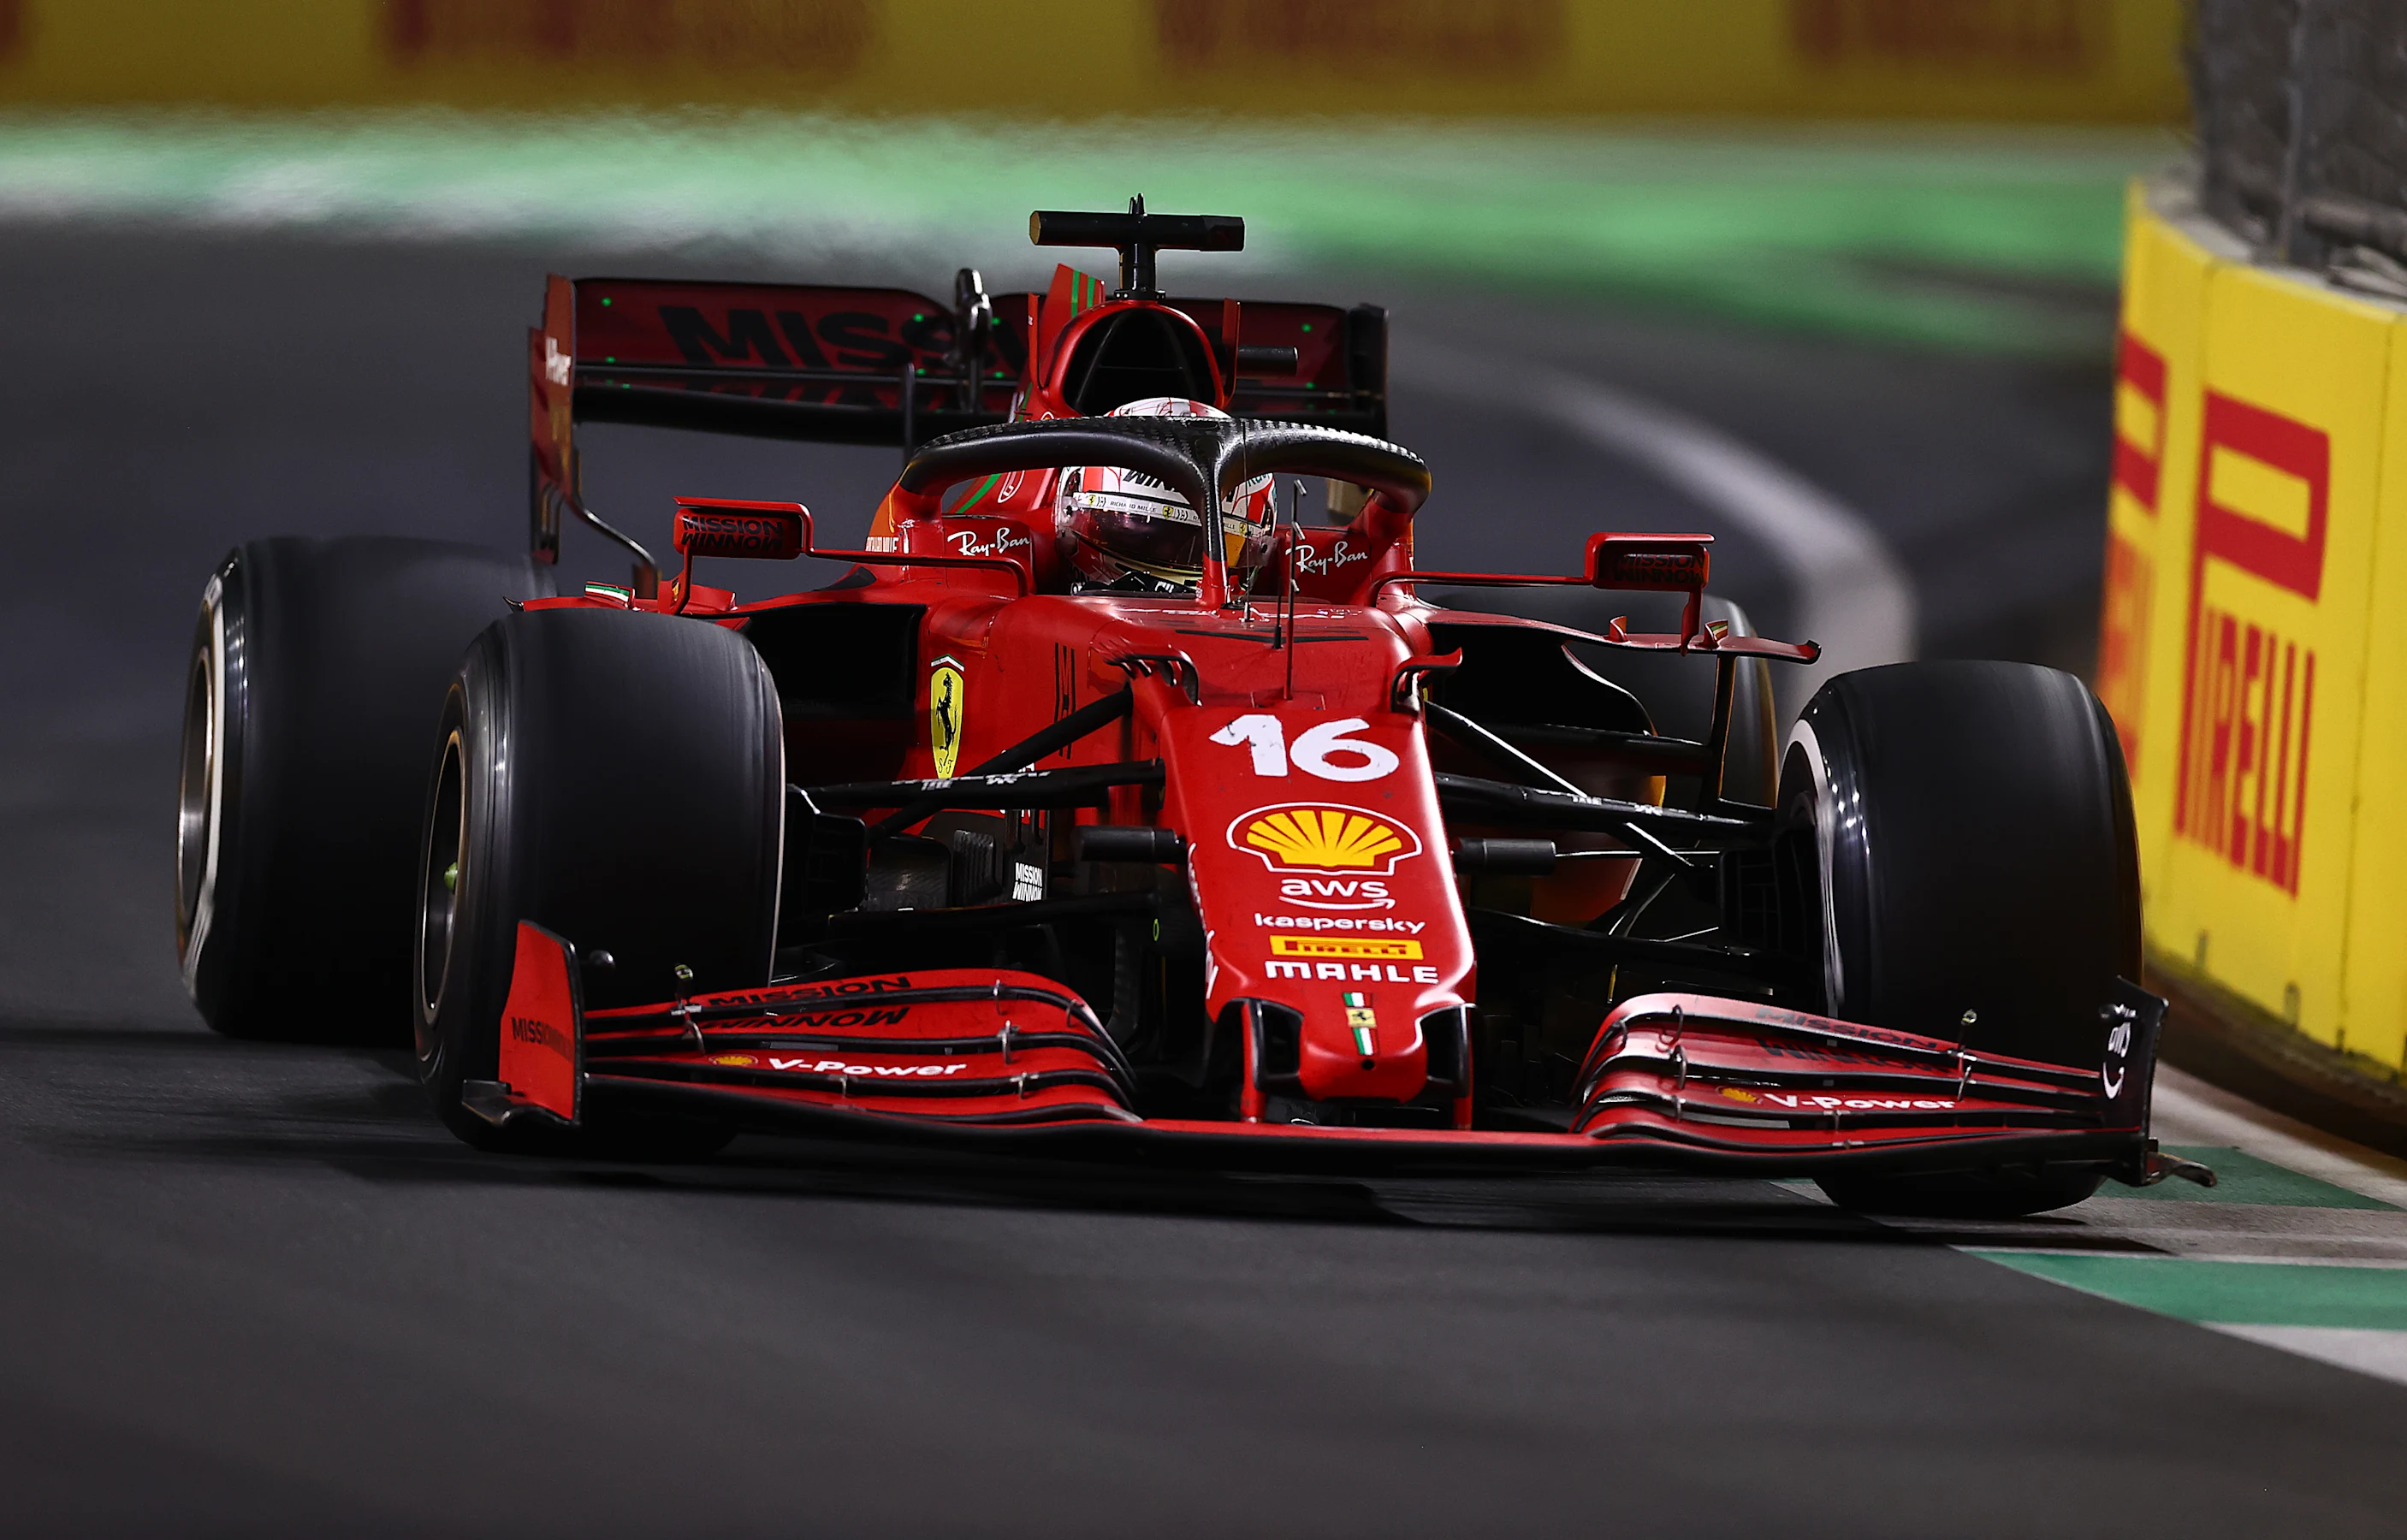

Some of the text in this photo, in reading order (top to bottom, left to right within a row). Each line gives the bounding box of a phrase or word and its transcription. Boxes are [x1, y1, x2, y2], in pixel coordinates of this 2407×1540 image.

[683, 515, 785, 536] MISSION
[681, 532, 784, 551] WINNOW
[947, 527, 1029, 556] Ray-Ban
[1285, 541, 1368, 576] Ray-Ban
[1209, 714, 1399, 782] 16
[1015, 862, 1043, 887] MISSION
[1012, 881, 1043, 902] WINNOW
[1281, 879, 1389, 899] aws
[1254, 913, 1426, 934] kaspersky
[1284, 939, 1407, 955] PIRELLI
[1265, 961, 1440, 985] MAHLE
[708, 975, 912, 1006] MISSION
[1755, 1007, 1938, 1049] MISSION
[769, 1057, 967, 1077] V-Power
[1764, 1093, 1957, 1111] V-Power
